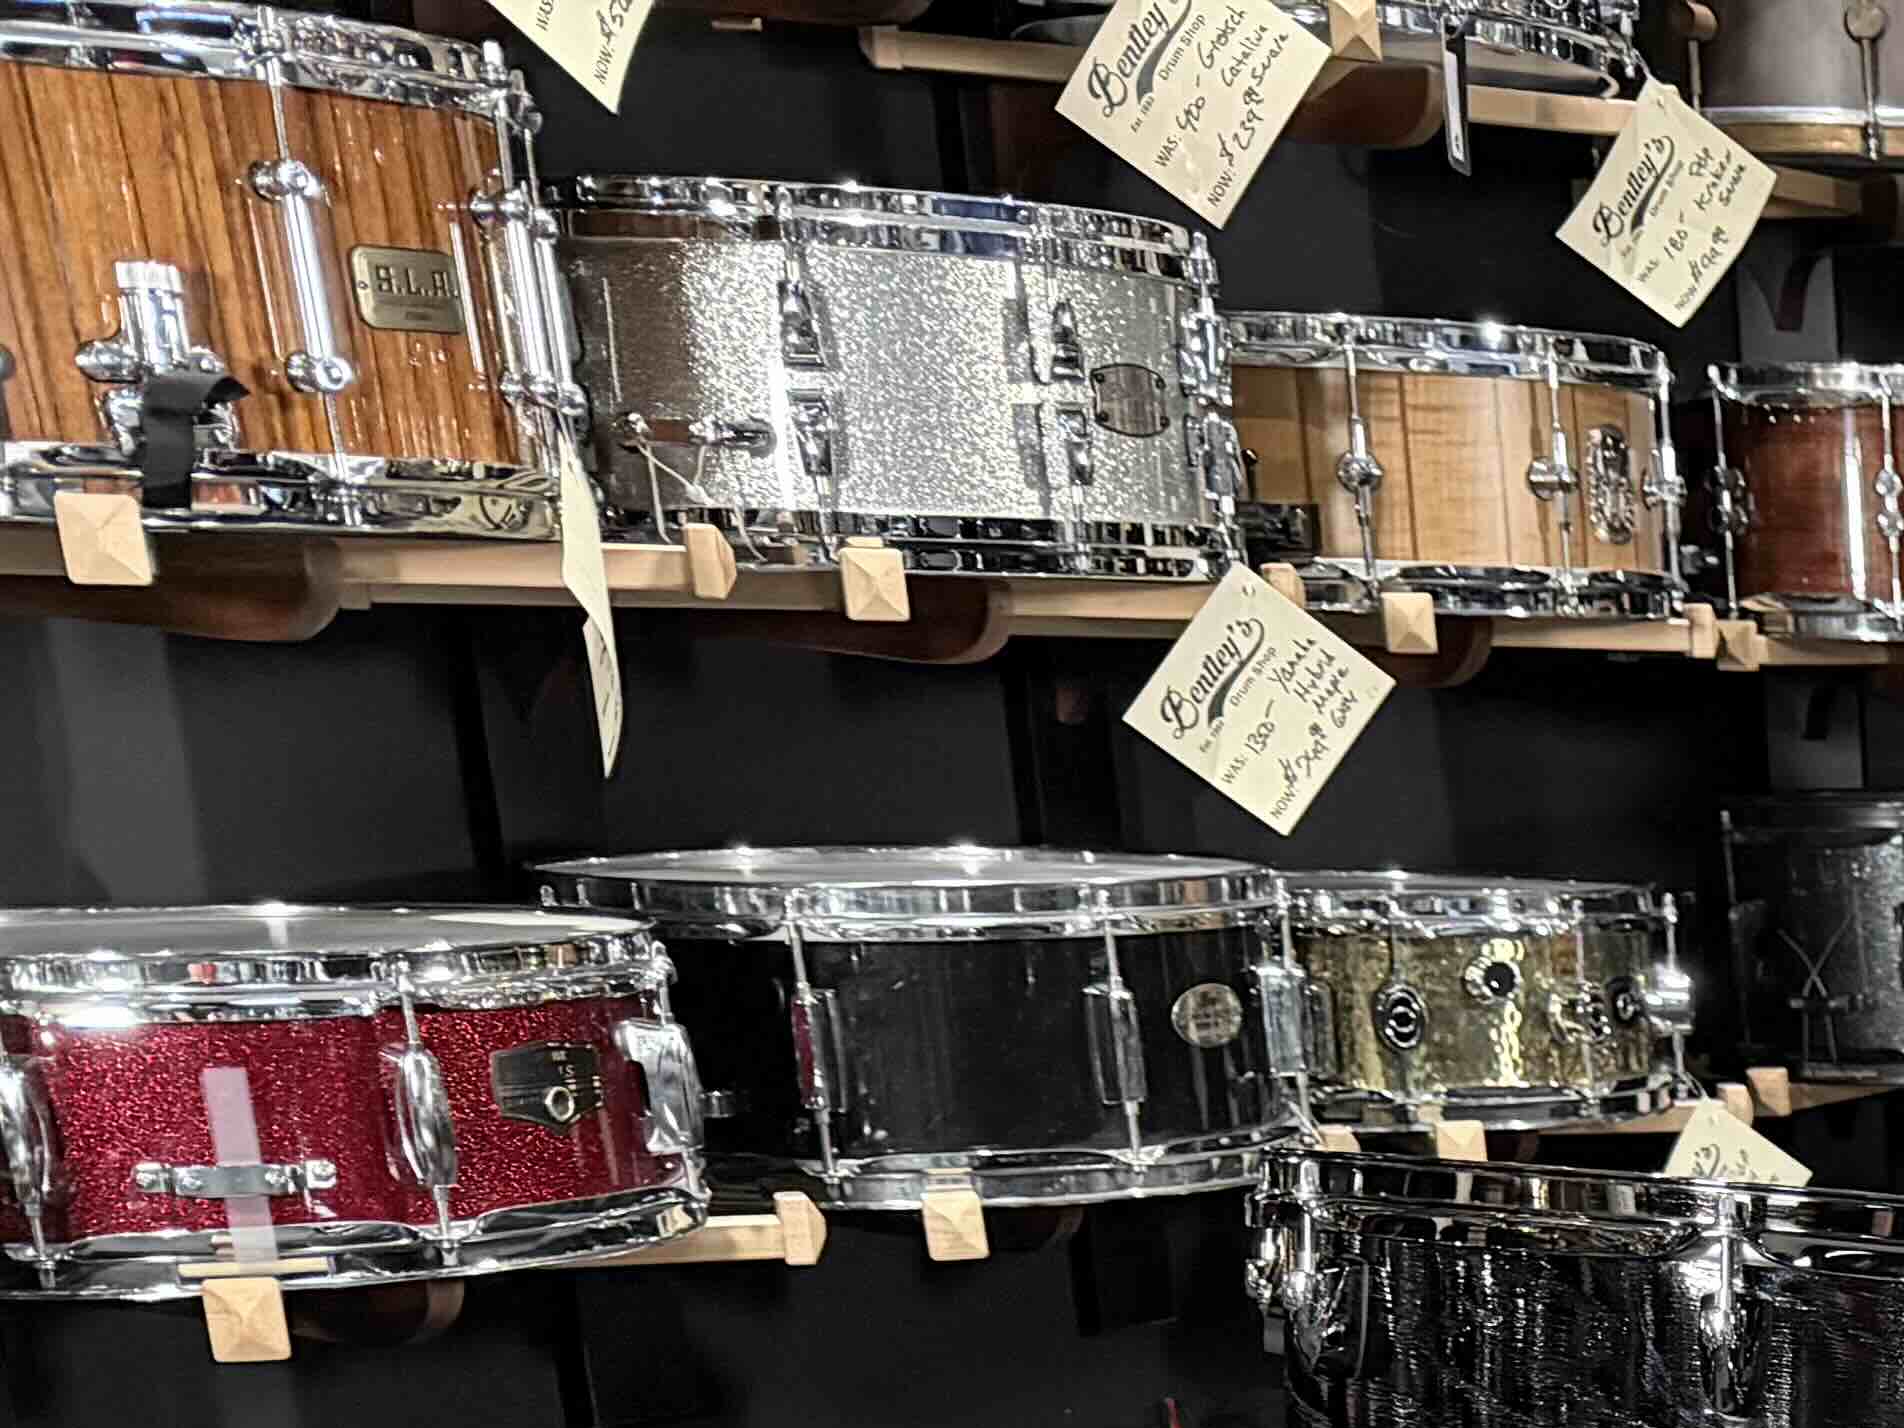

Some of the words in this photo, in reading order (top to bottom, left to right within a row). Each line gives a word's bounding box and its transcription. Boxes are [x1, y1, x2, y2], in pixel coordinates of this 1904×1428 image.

[1158, 42, 1191, 81] Drum
[1180, 14, 1207, 47] Shop
[1154, 136, 1184, 168] WAS:
[1206, 167, 1238, 207] NOW:
[1593, 135, 1668, 248] Bentley's
[1160, 618, 1252, 741] Bentley's
[1230, 674, 1256, 708] Drum
[1253, 646, 1279, 678] Shop
[1221, 753, 1249, 786] WAS:
